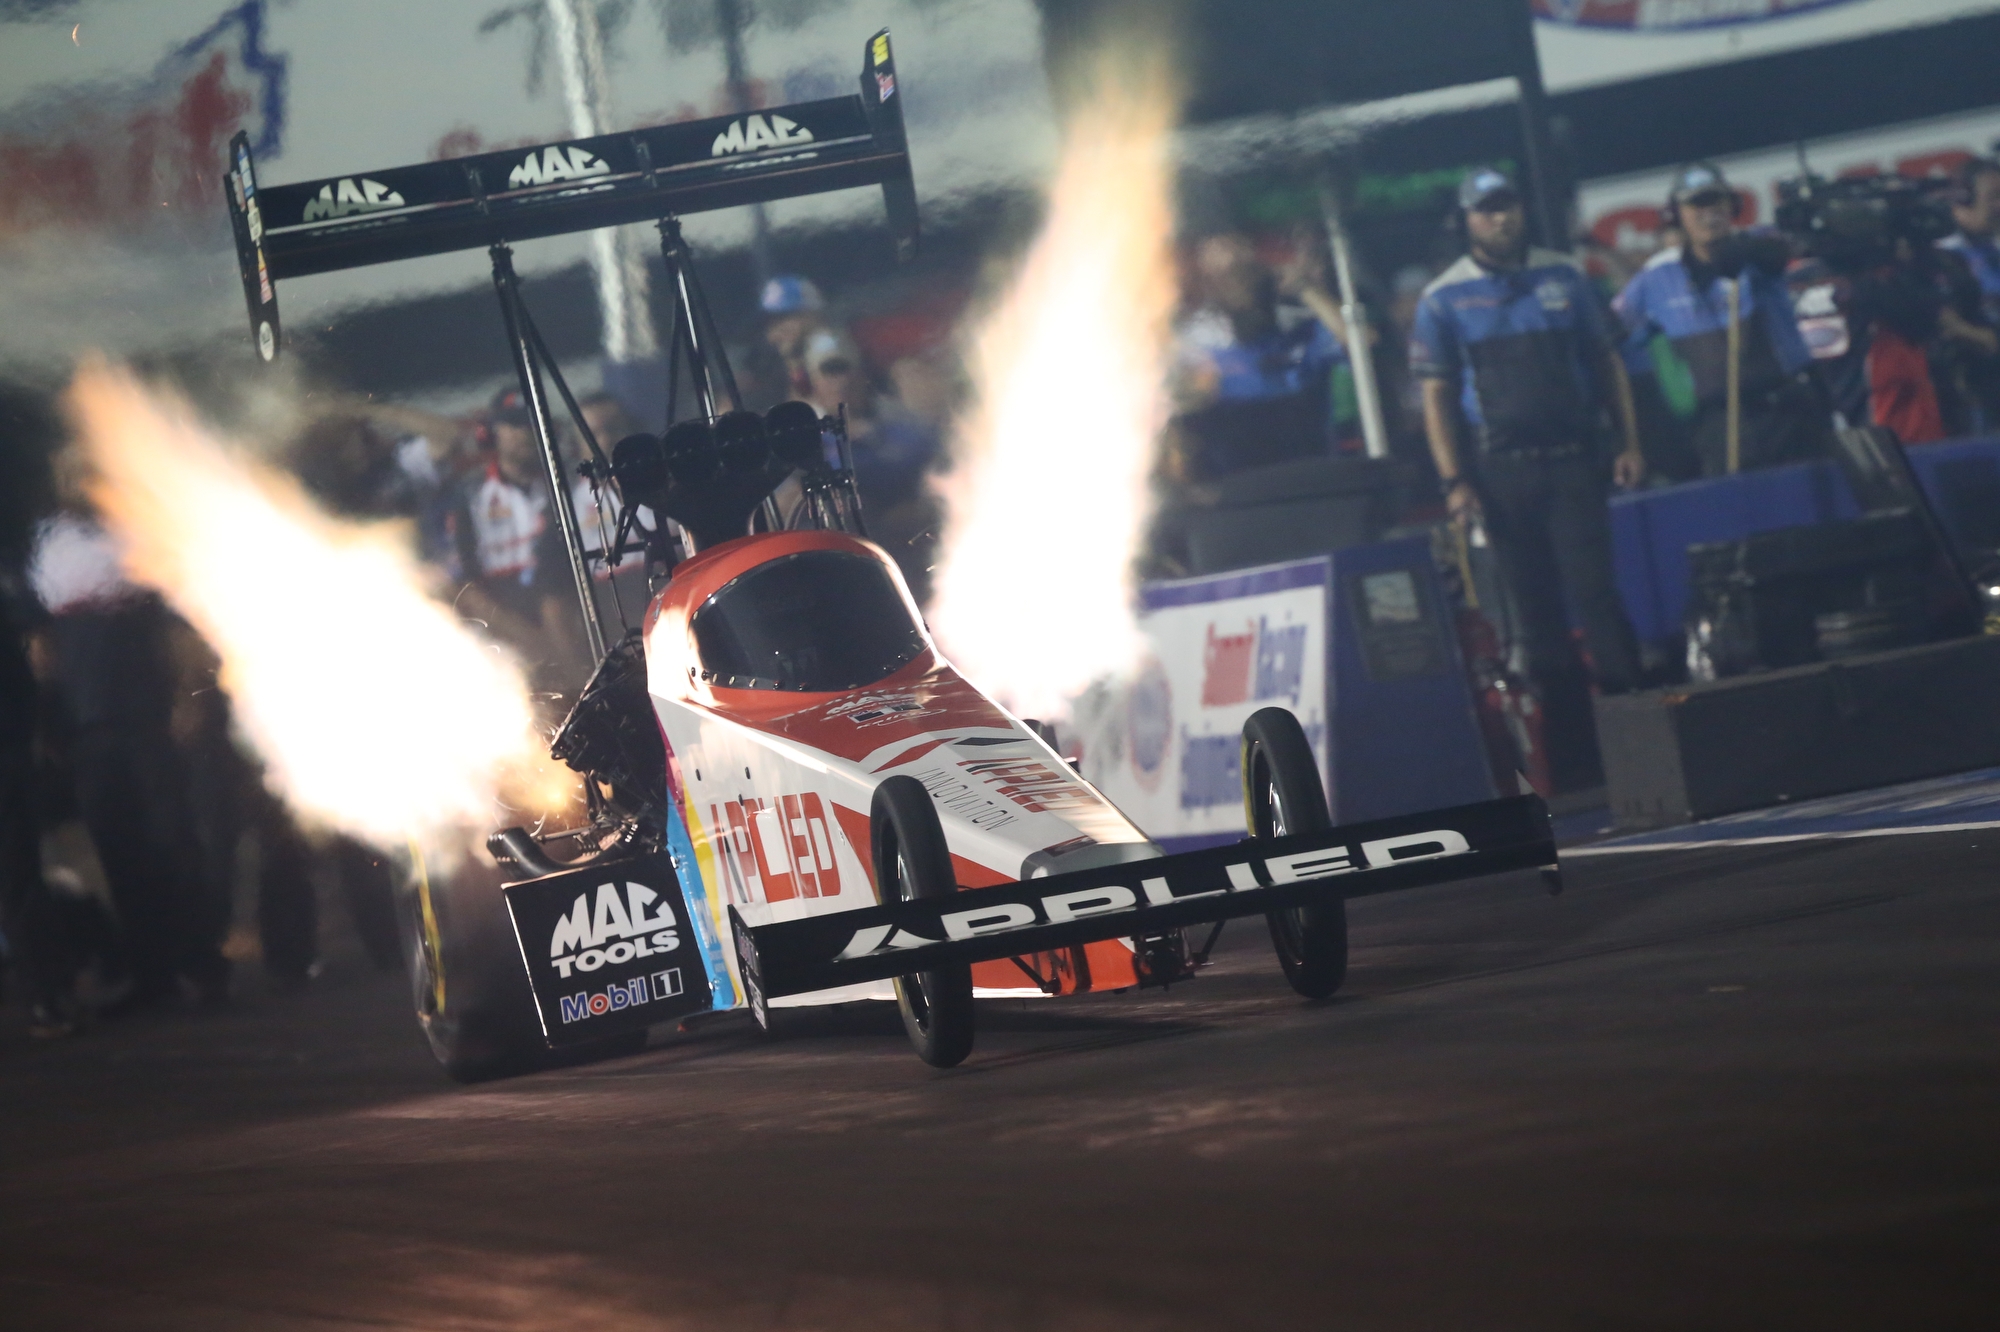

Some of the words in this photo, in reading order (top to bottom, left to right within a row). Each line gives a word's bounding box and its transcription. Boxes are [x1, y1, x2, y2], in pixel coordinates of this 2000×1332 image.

[711, 114, 814, 157] MAC
[509, 146, 611, 190] MAC
[303, 178, 405, 223] MAC
[913, 767, 1019, 831] INNOVATION
[551, 881, 677, 958] MAC
[832, 829, 1470, 962] APPLIED
[551, 929, 680, 979] TOOLS
[560, 976, 649, 1024] Mobil
